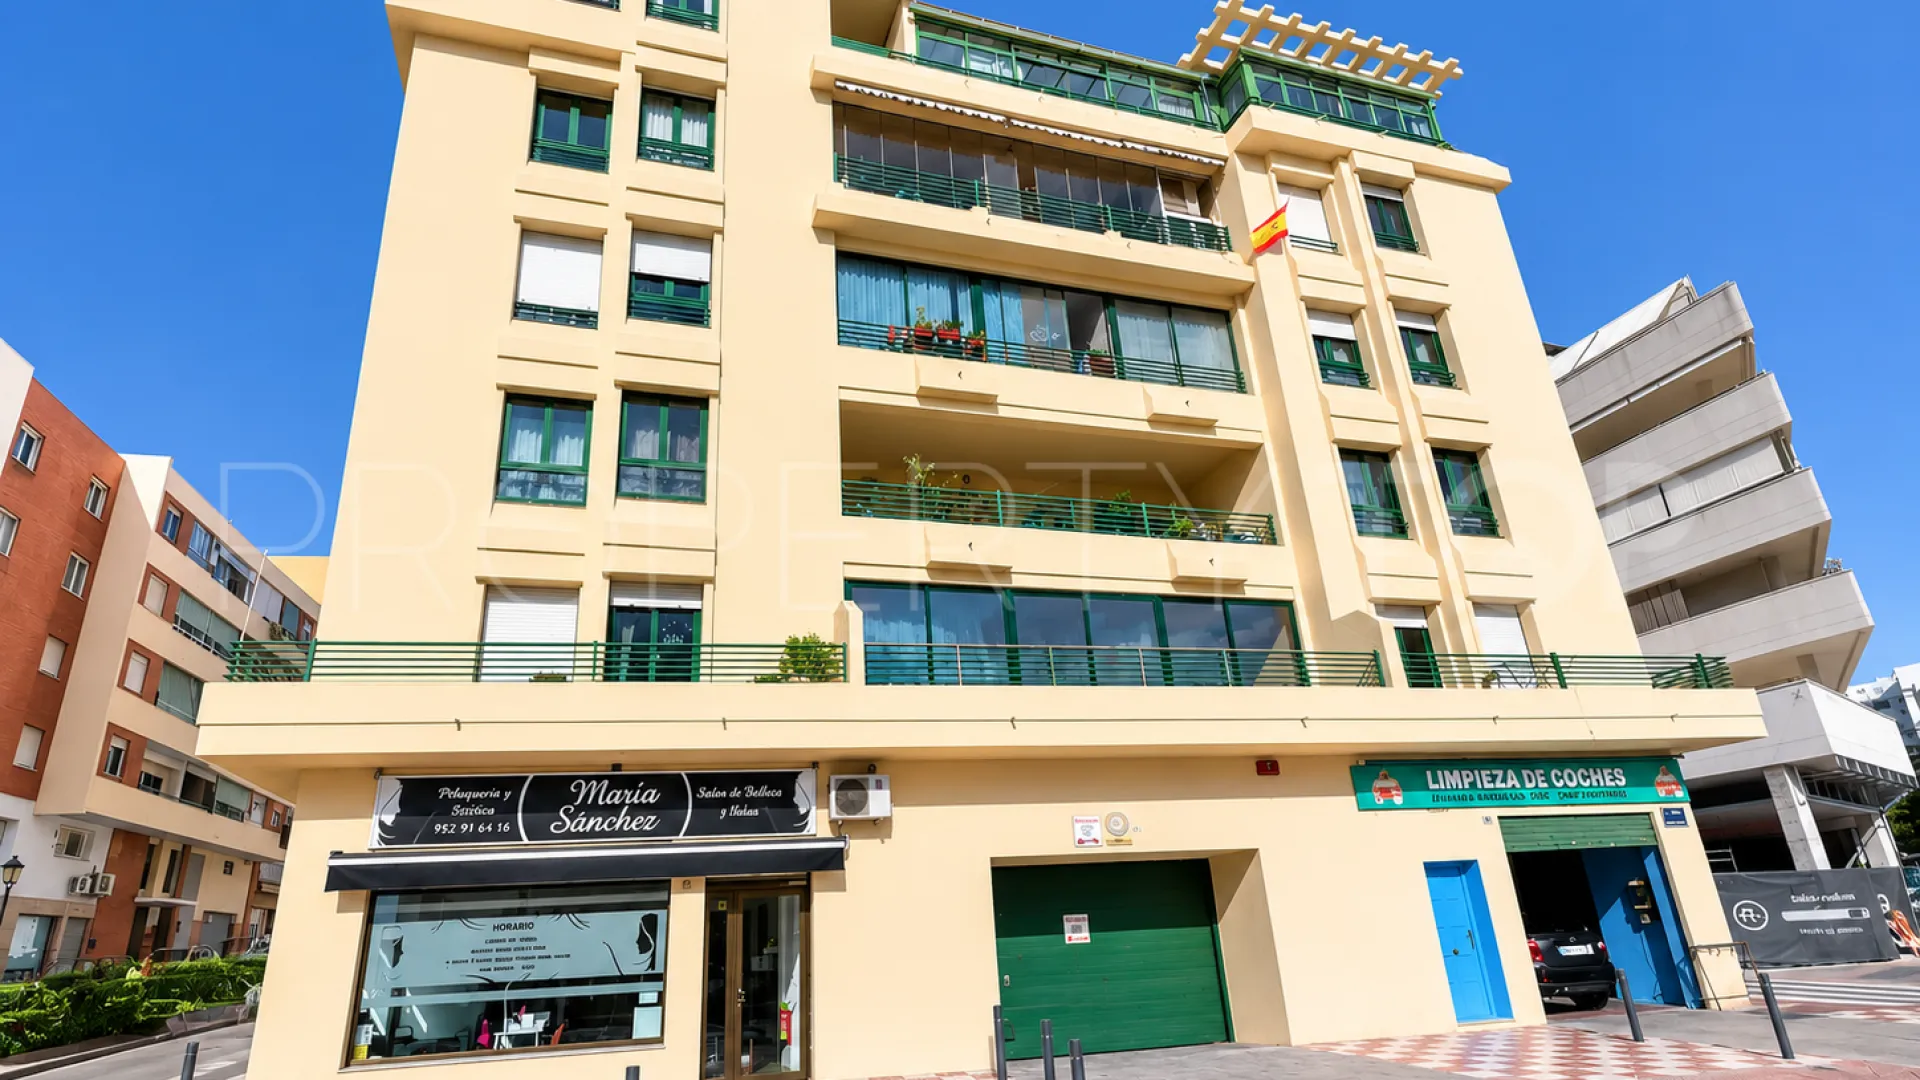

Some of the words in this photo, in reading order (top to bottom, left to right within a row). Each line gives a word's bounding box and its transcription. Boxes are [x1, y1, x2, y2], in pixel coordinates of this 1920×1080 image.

[1426, 769, 1517, 790] LIMPIEZA
[1523, 769, 1549, 788] DE
[1551, 768, 1626, 788] COCHES
[570, 779, 661, 805] María
[460, 823, 474, 833] 91
[549, 805, 661, 833] Sánchez
[493, 921, 535, 932] HORARIO
